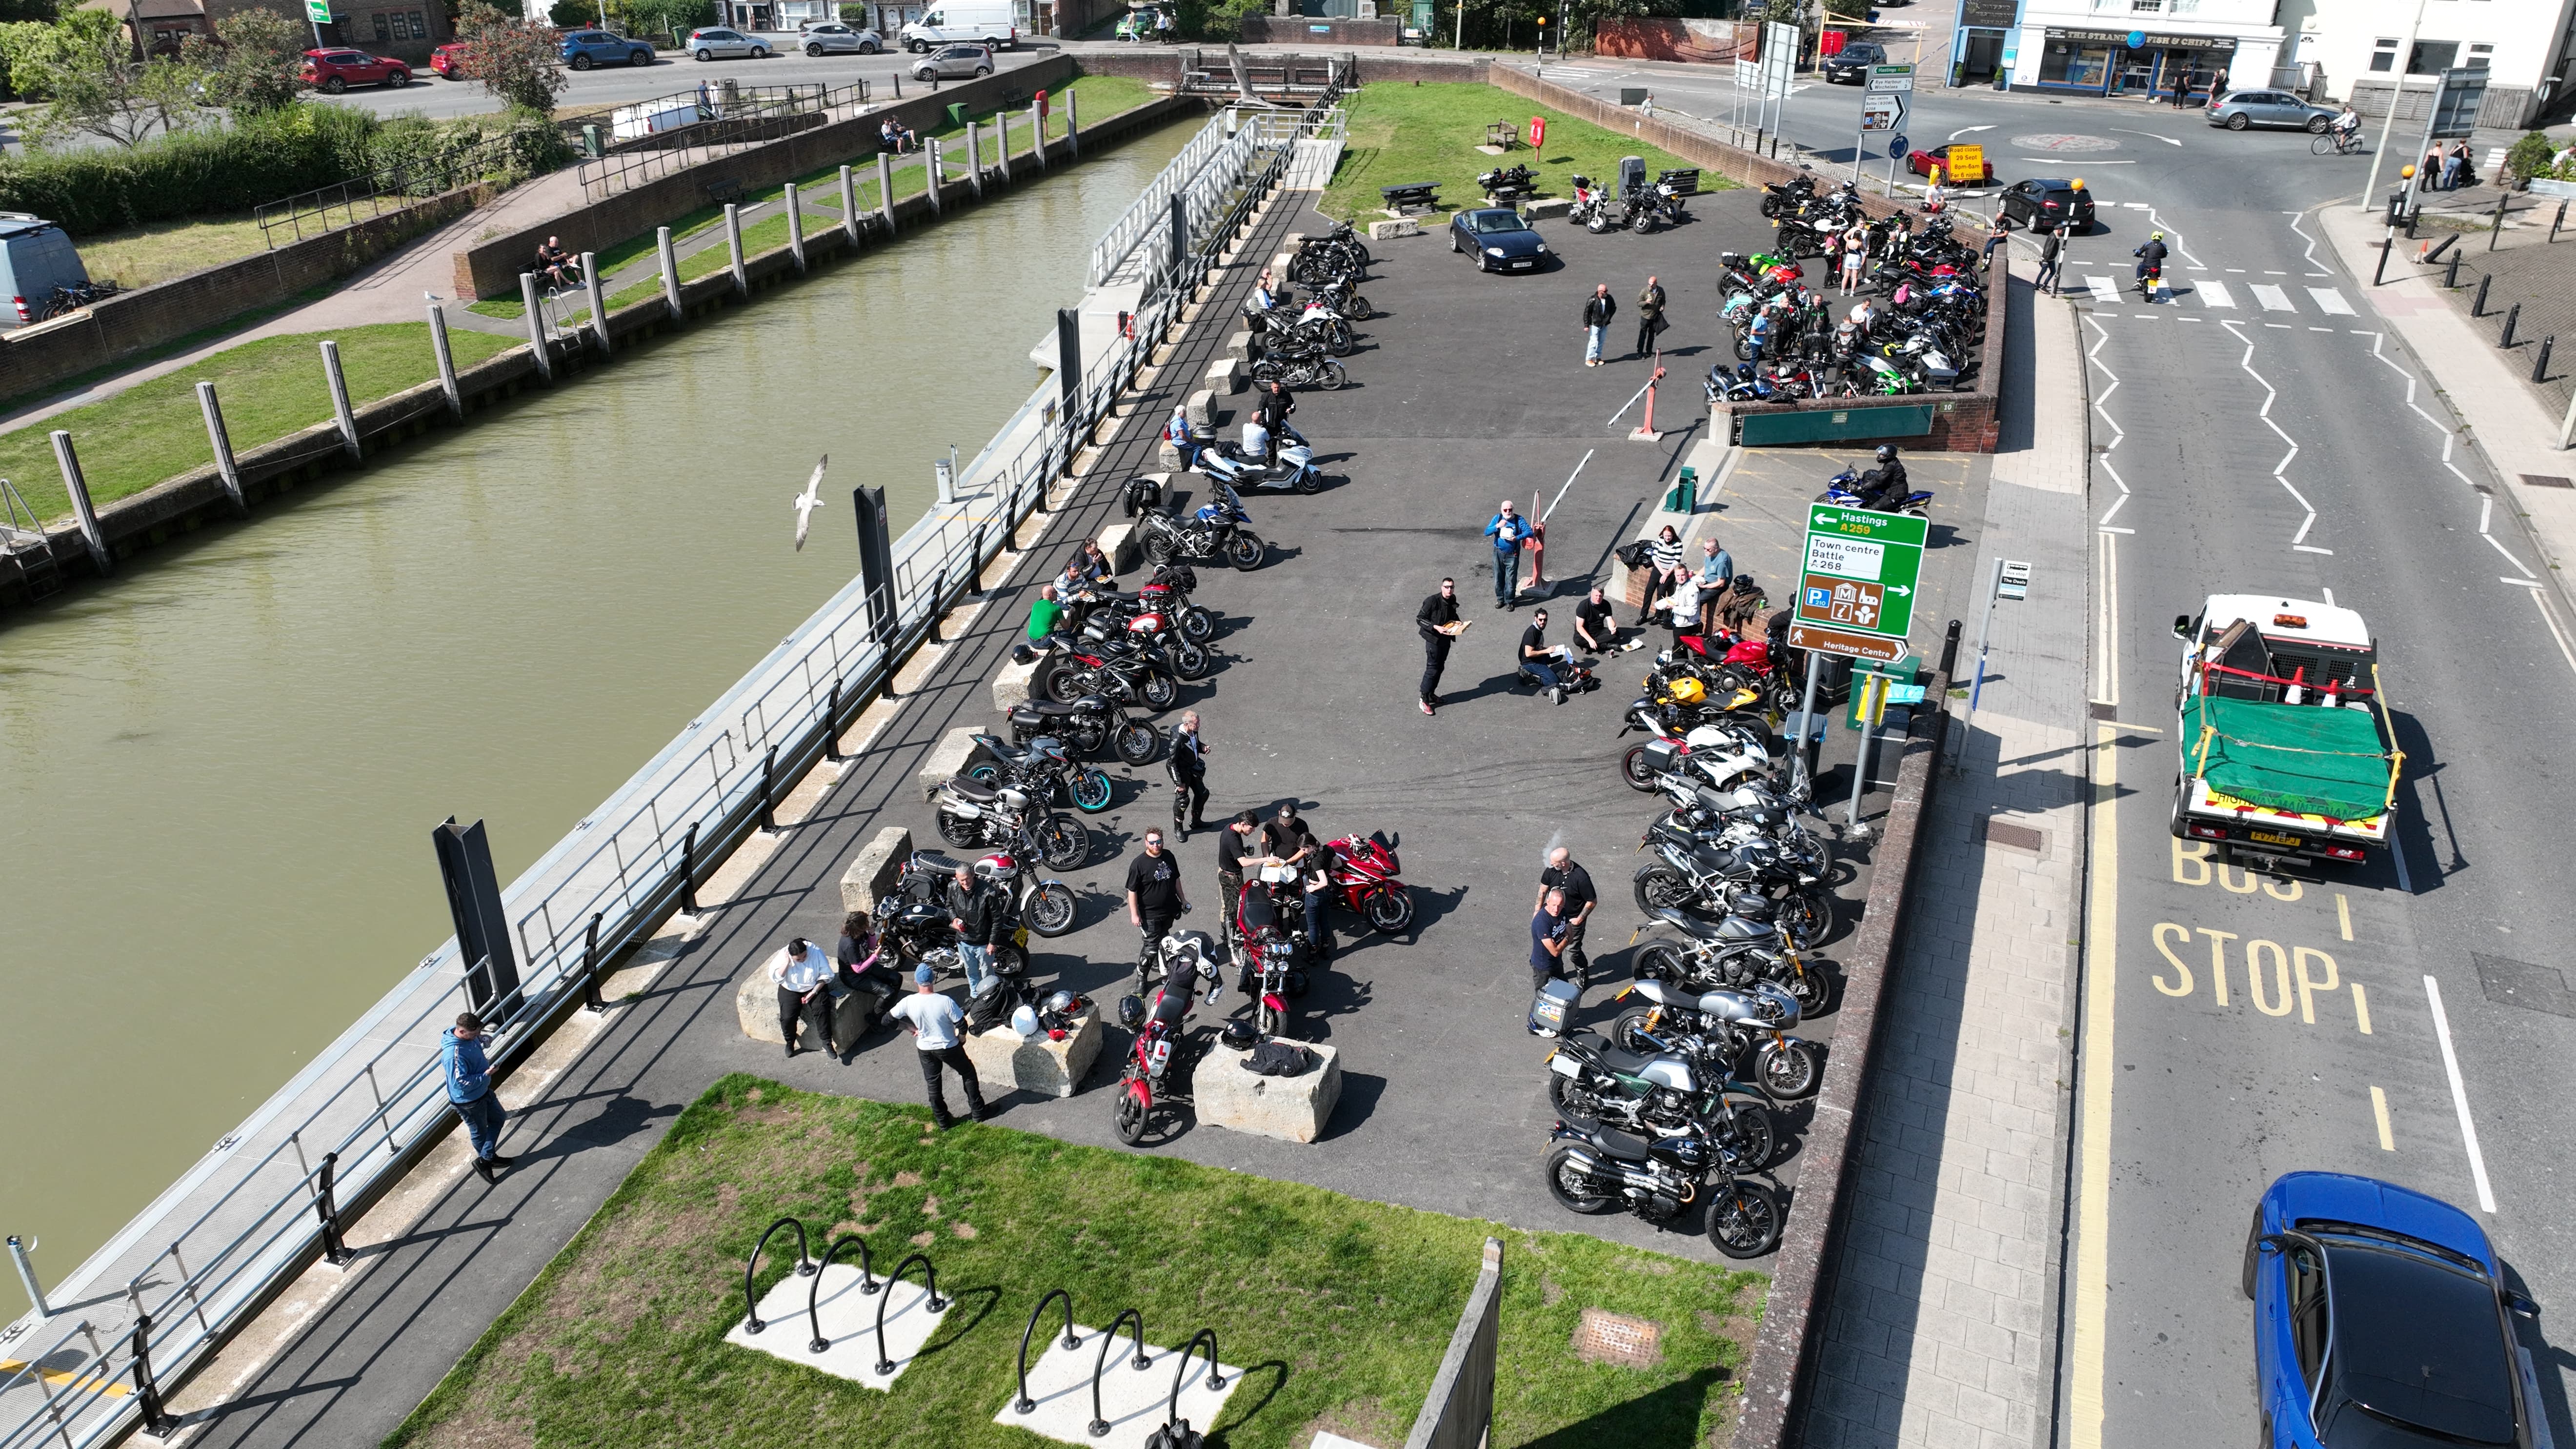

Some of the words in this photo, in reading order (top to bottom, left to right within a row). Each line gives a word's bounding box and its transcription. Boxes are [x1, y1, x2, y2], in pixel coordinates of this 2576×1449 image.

[2088, 32, 2128, 42] STRAND
[2147, 36, 2170, 44] FISH
[2181, 38, 2212, 47] CHIPS
[1841, 512, 1888, 527] Hastings
[1812, 549, 1844, 561] Battle
[1814, 539, 1841, 550] Town
[1845, 545, 1879, 556] centre
[1809, 589, 1822, 604] P
[1824, 641, 1859, 654] Heritage
[1862, 646, 1891, 658] Centre
[2218, 792, 2273, 807] HIGHWAY
[2277, 799, 2369, 822] MAINTENANCE
[2254, 832, 2278, 842] FV73
[2279, 836, 2297, 845] EPJ
[2172, 835, 2303, 902] BUS
[2152, 923, 2339, 1025] STOP
[1158, 1045, 1167, 1056] L
